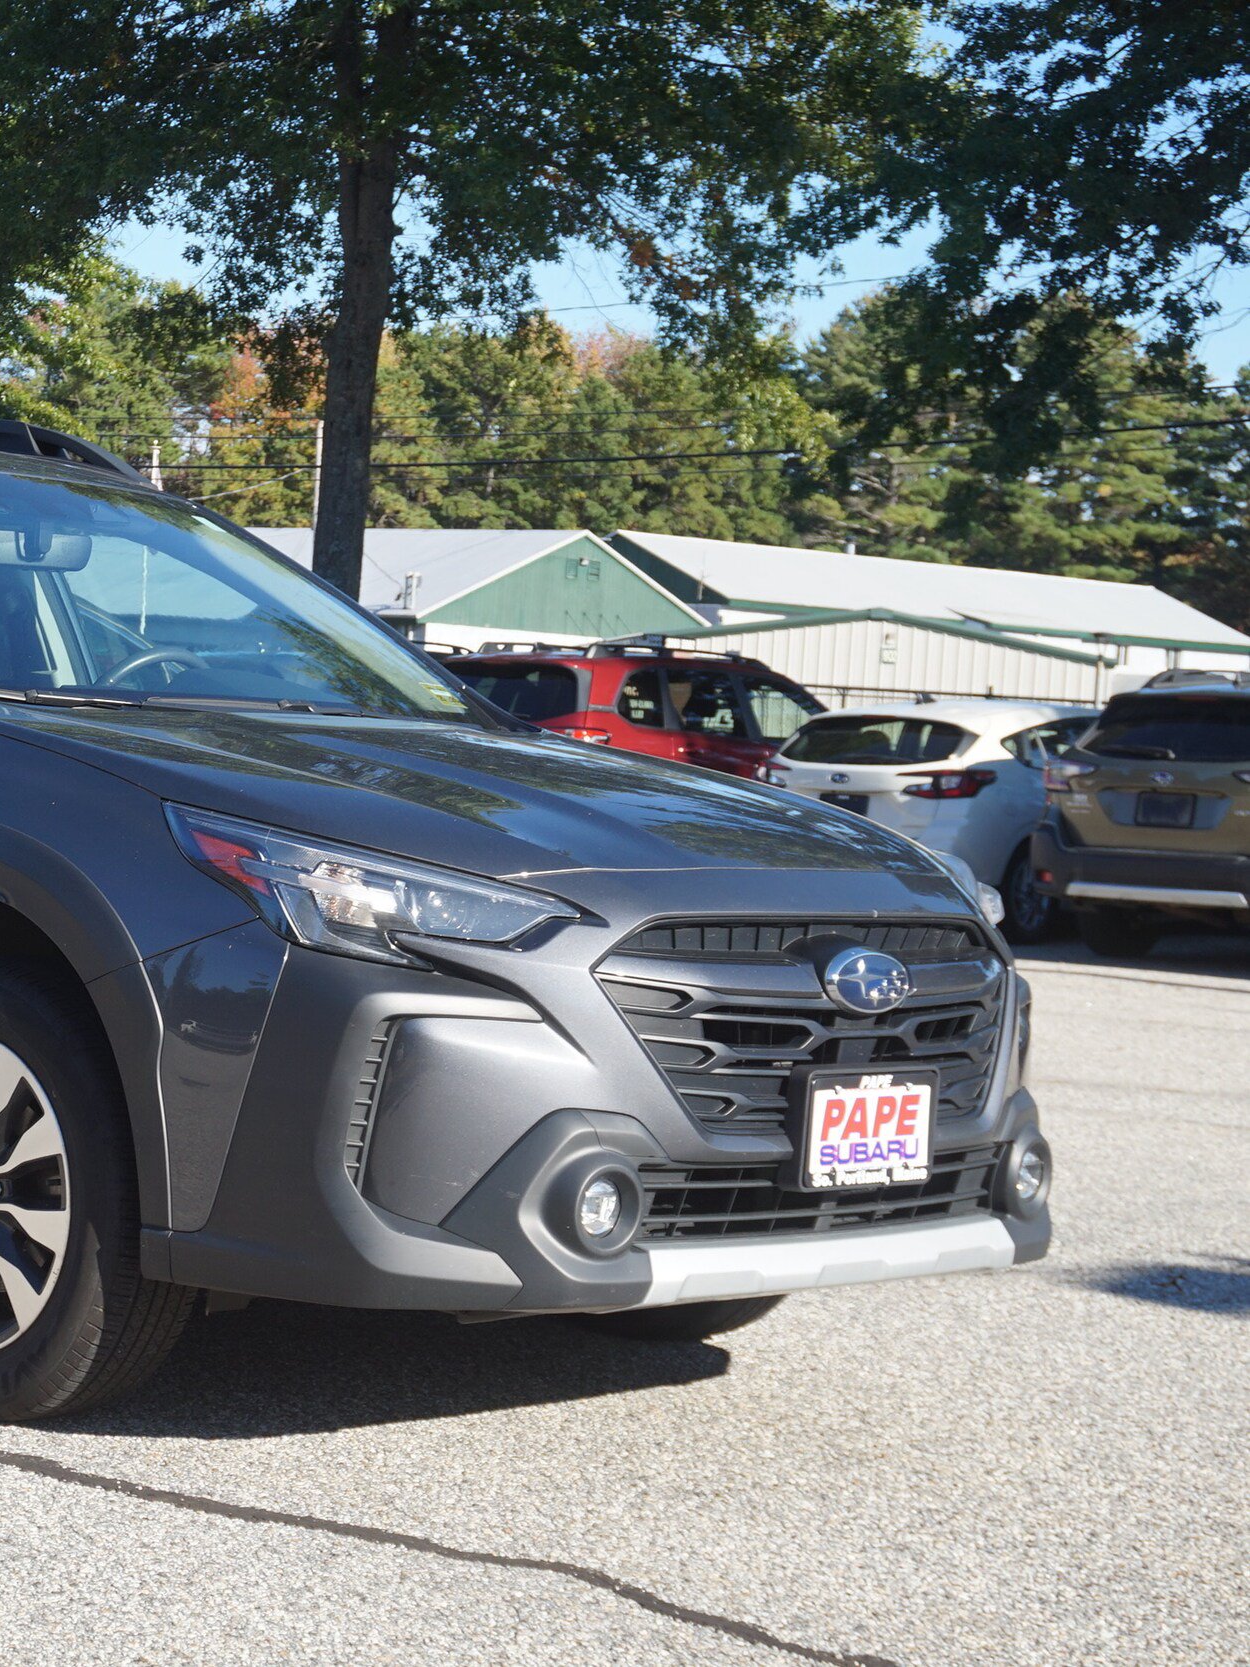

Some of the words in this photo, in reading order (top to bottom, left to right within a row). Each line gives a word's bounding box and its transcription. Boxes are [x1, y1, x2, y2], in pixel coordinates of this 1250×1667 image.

[859, 1075, 894, 1089] PAPE
[821, 1095, 921, 1141] PAPE
[820, 1139, 918, 1166] SUBARU
